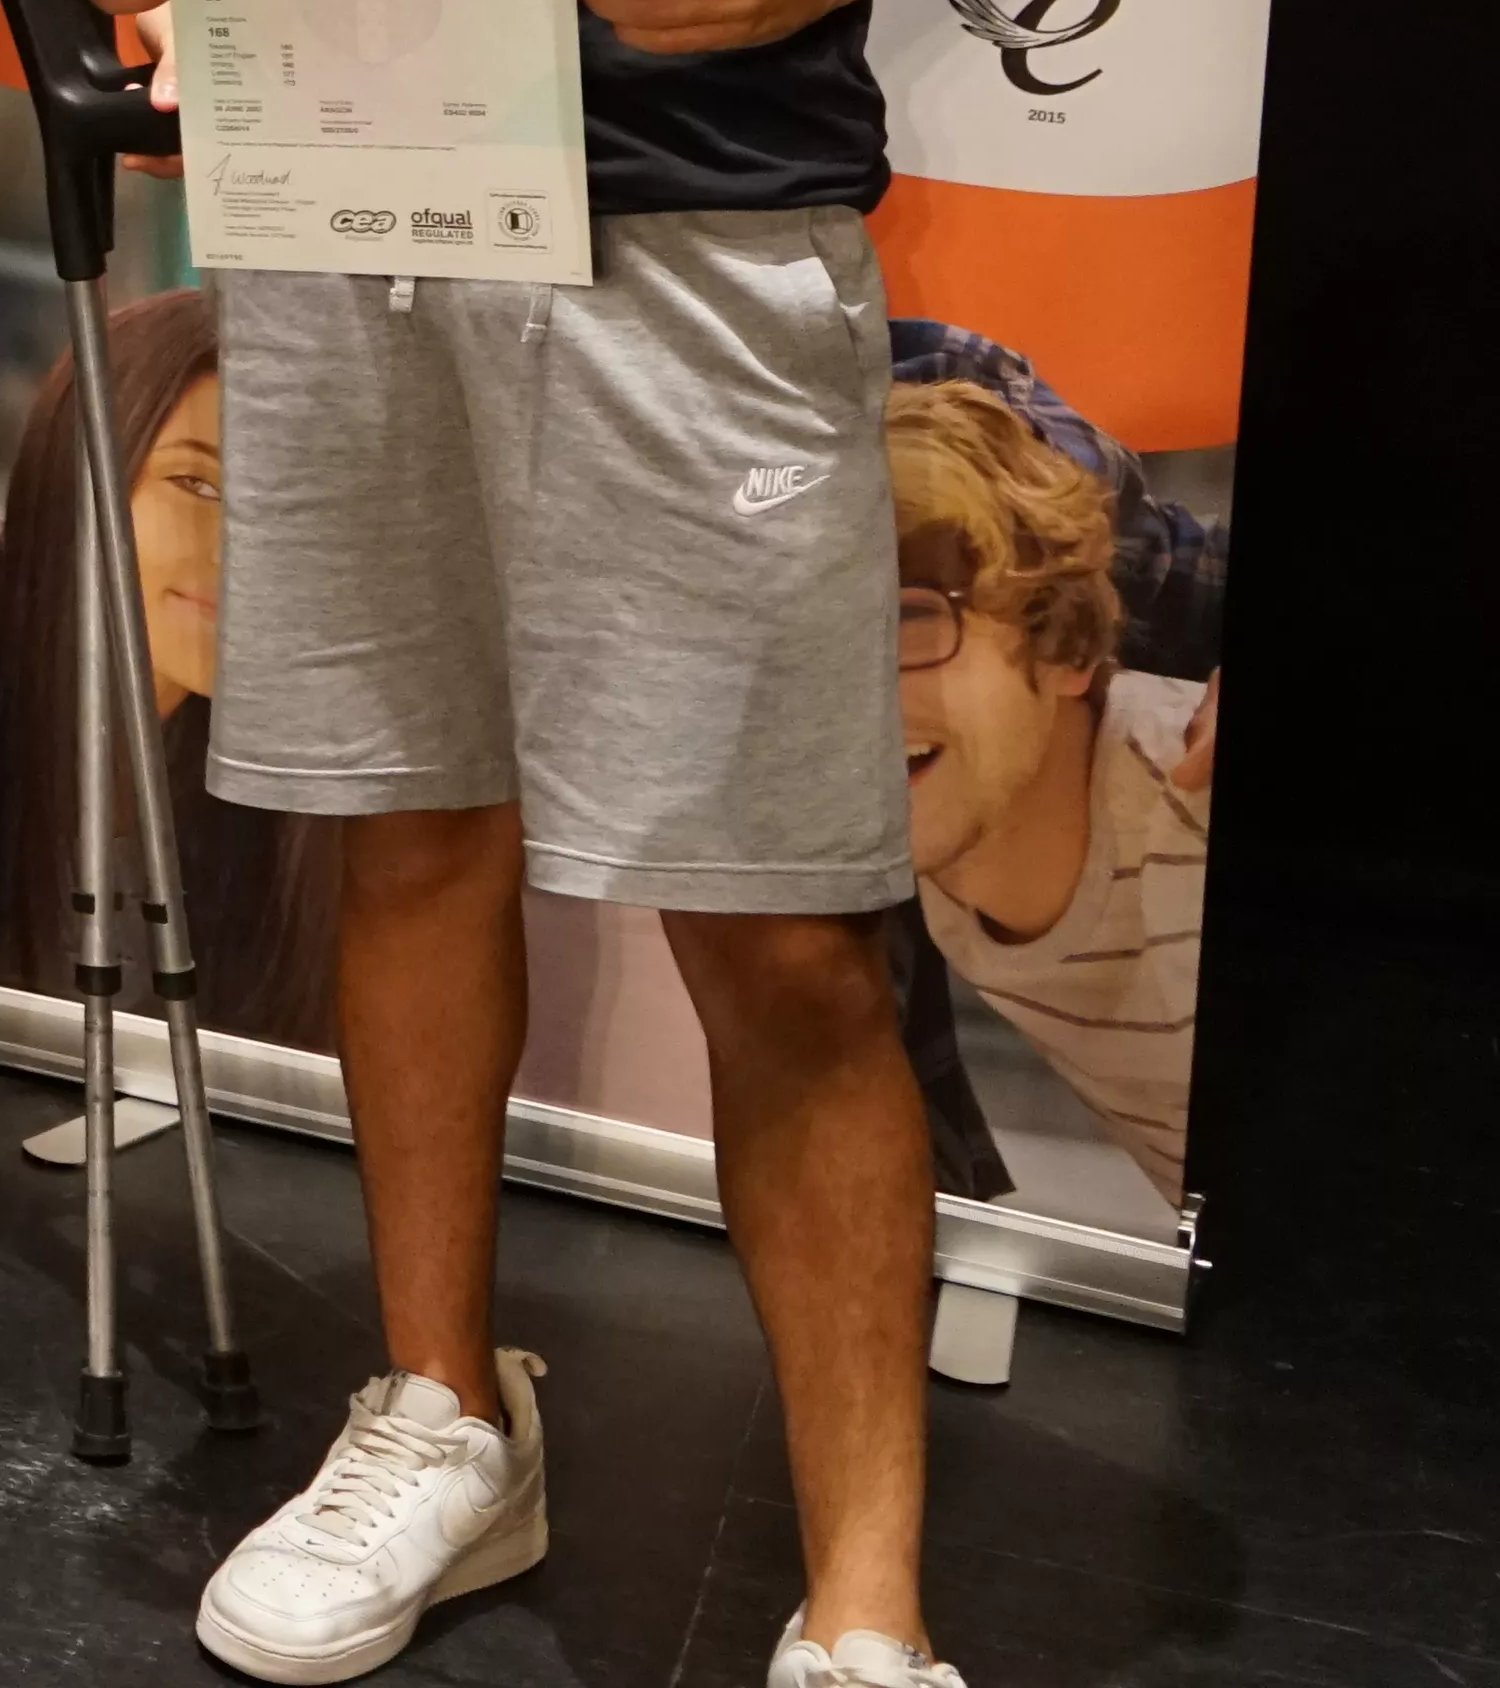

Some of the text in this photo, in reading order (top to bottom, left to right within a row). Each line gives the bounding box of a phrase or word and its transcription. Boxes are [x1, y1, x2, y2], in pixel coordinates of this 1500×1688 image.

[1027, 108, 1067, 125] 2015
[410, 207, 473, 229] ofqual
[411, 229, 475, 240] REGULATED
[746, 465, 805, 498] NIKE
